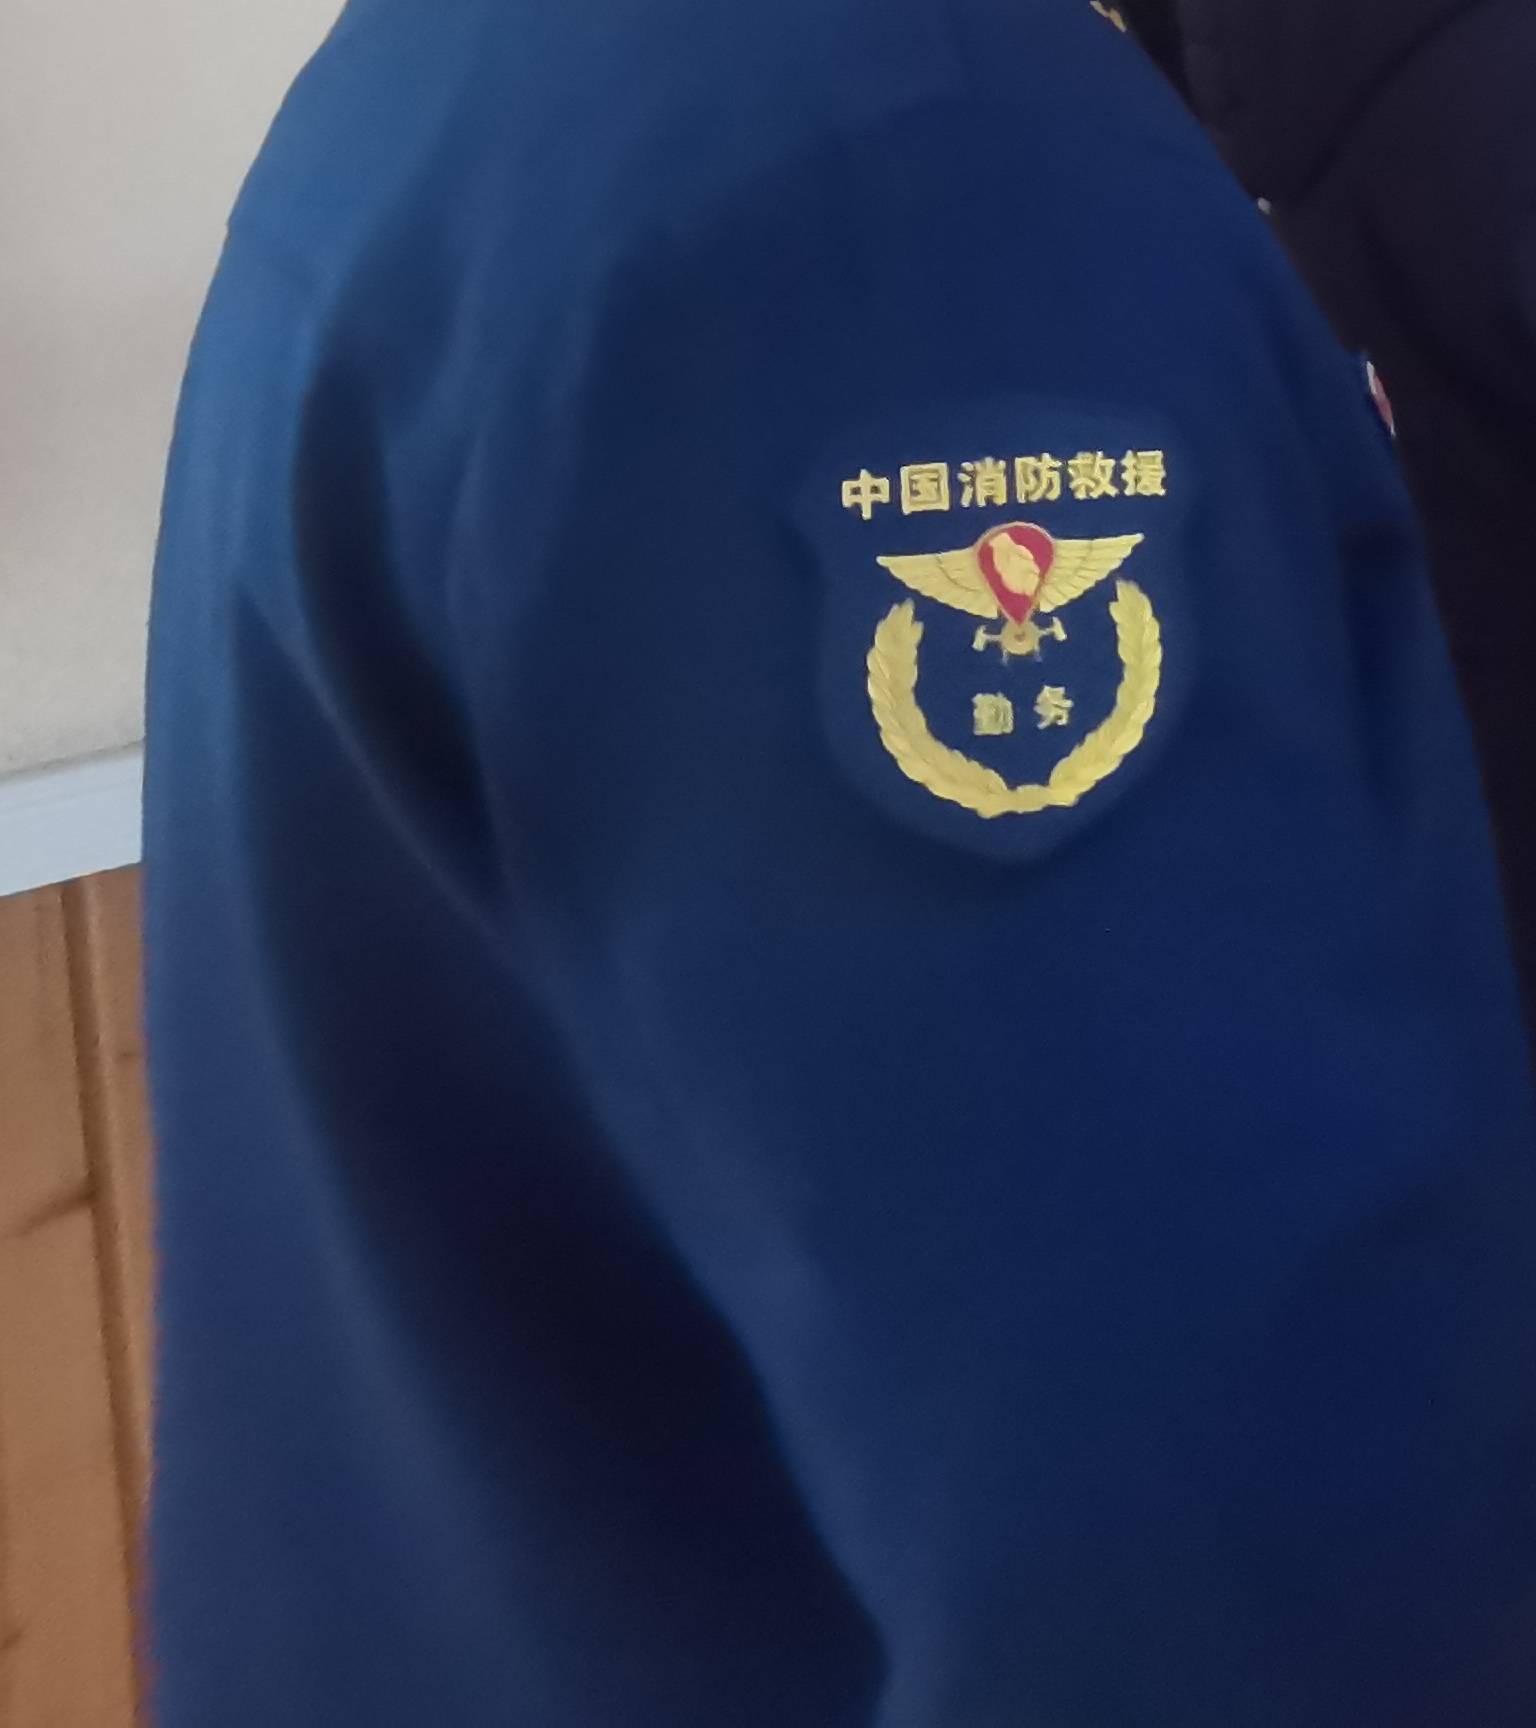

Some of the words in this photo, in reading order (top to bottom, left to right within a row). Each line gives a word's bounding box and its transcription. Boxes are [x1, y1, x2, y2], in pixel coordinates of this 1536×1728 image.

[841, 450, 1167, 520] 中国消防救援
